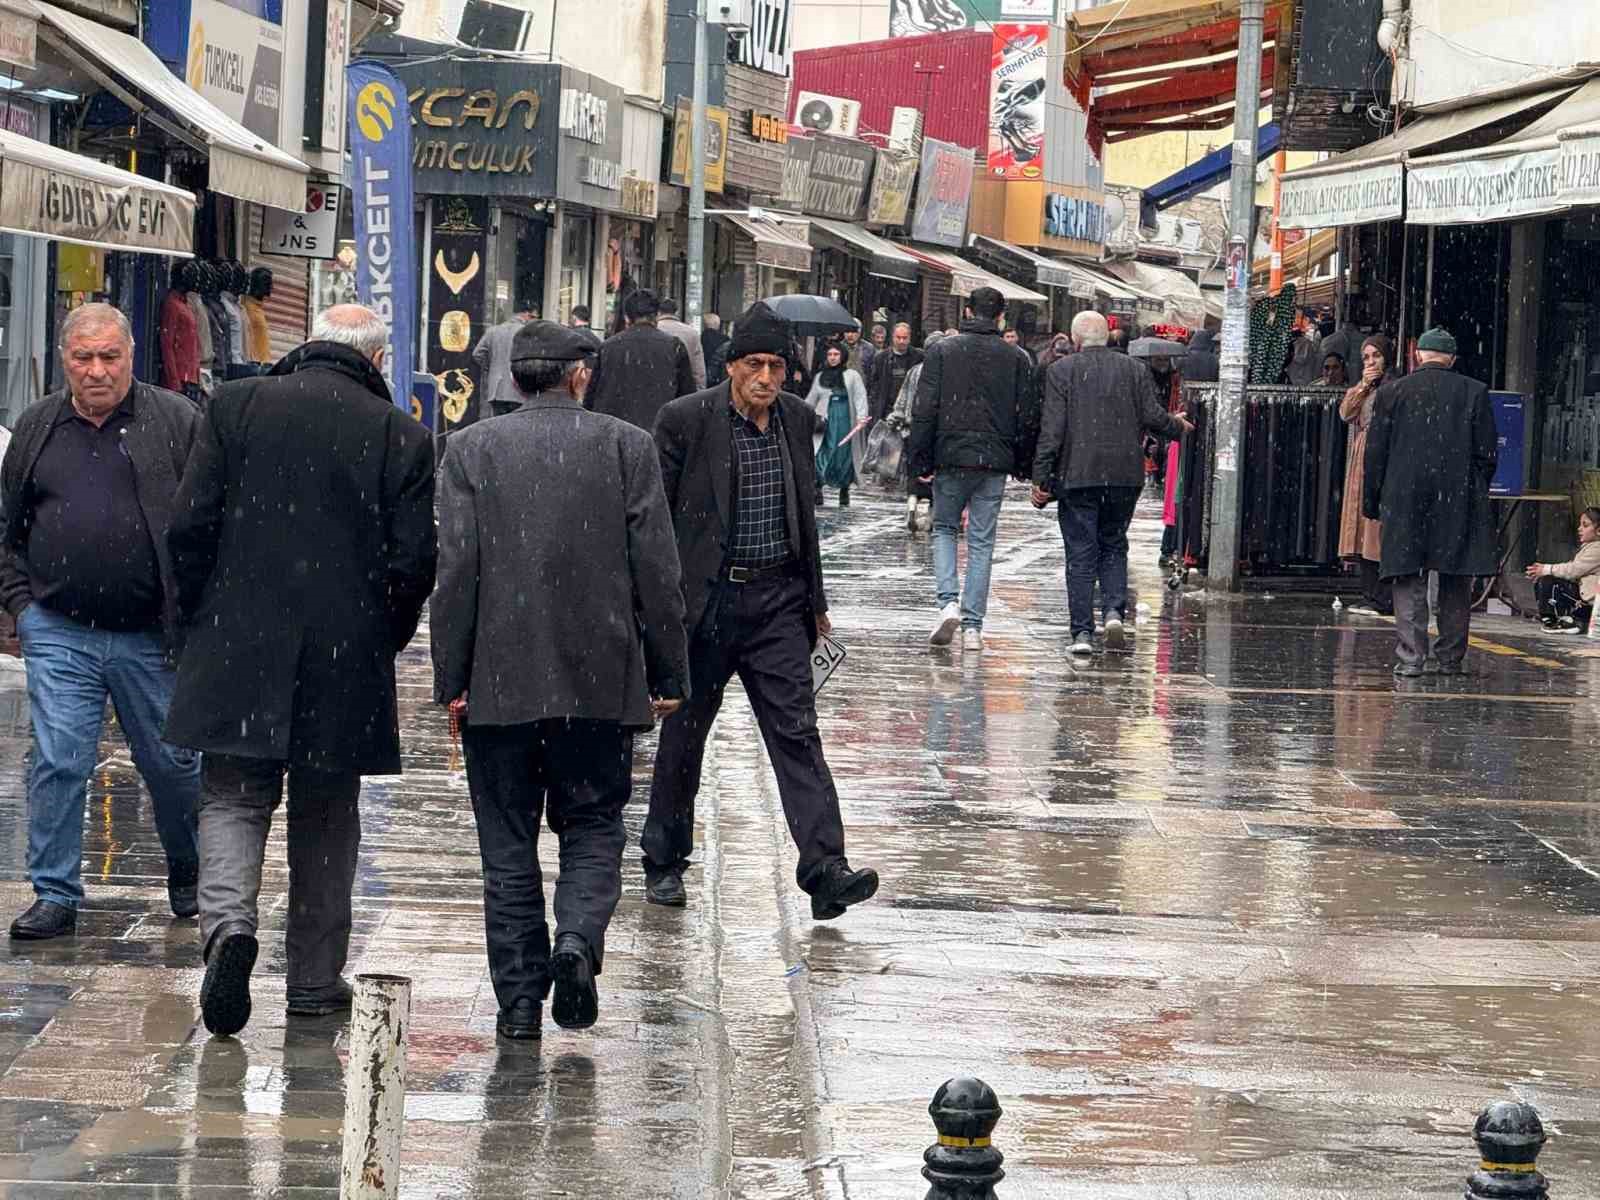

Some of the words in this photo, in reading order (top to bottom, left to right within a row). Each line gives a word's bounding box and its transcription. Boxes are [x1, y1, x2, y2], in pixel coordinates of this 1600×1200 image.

[204, 43, 244, 95] TURKCELL
[294, 216, 307, 229] &
[279, 234, 317, 249] JNS
